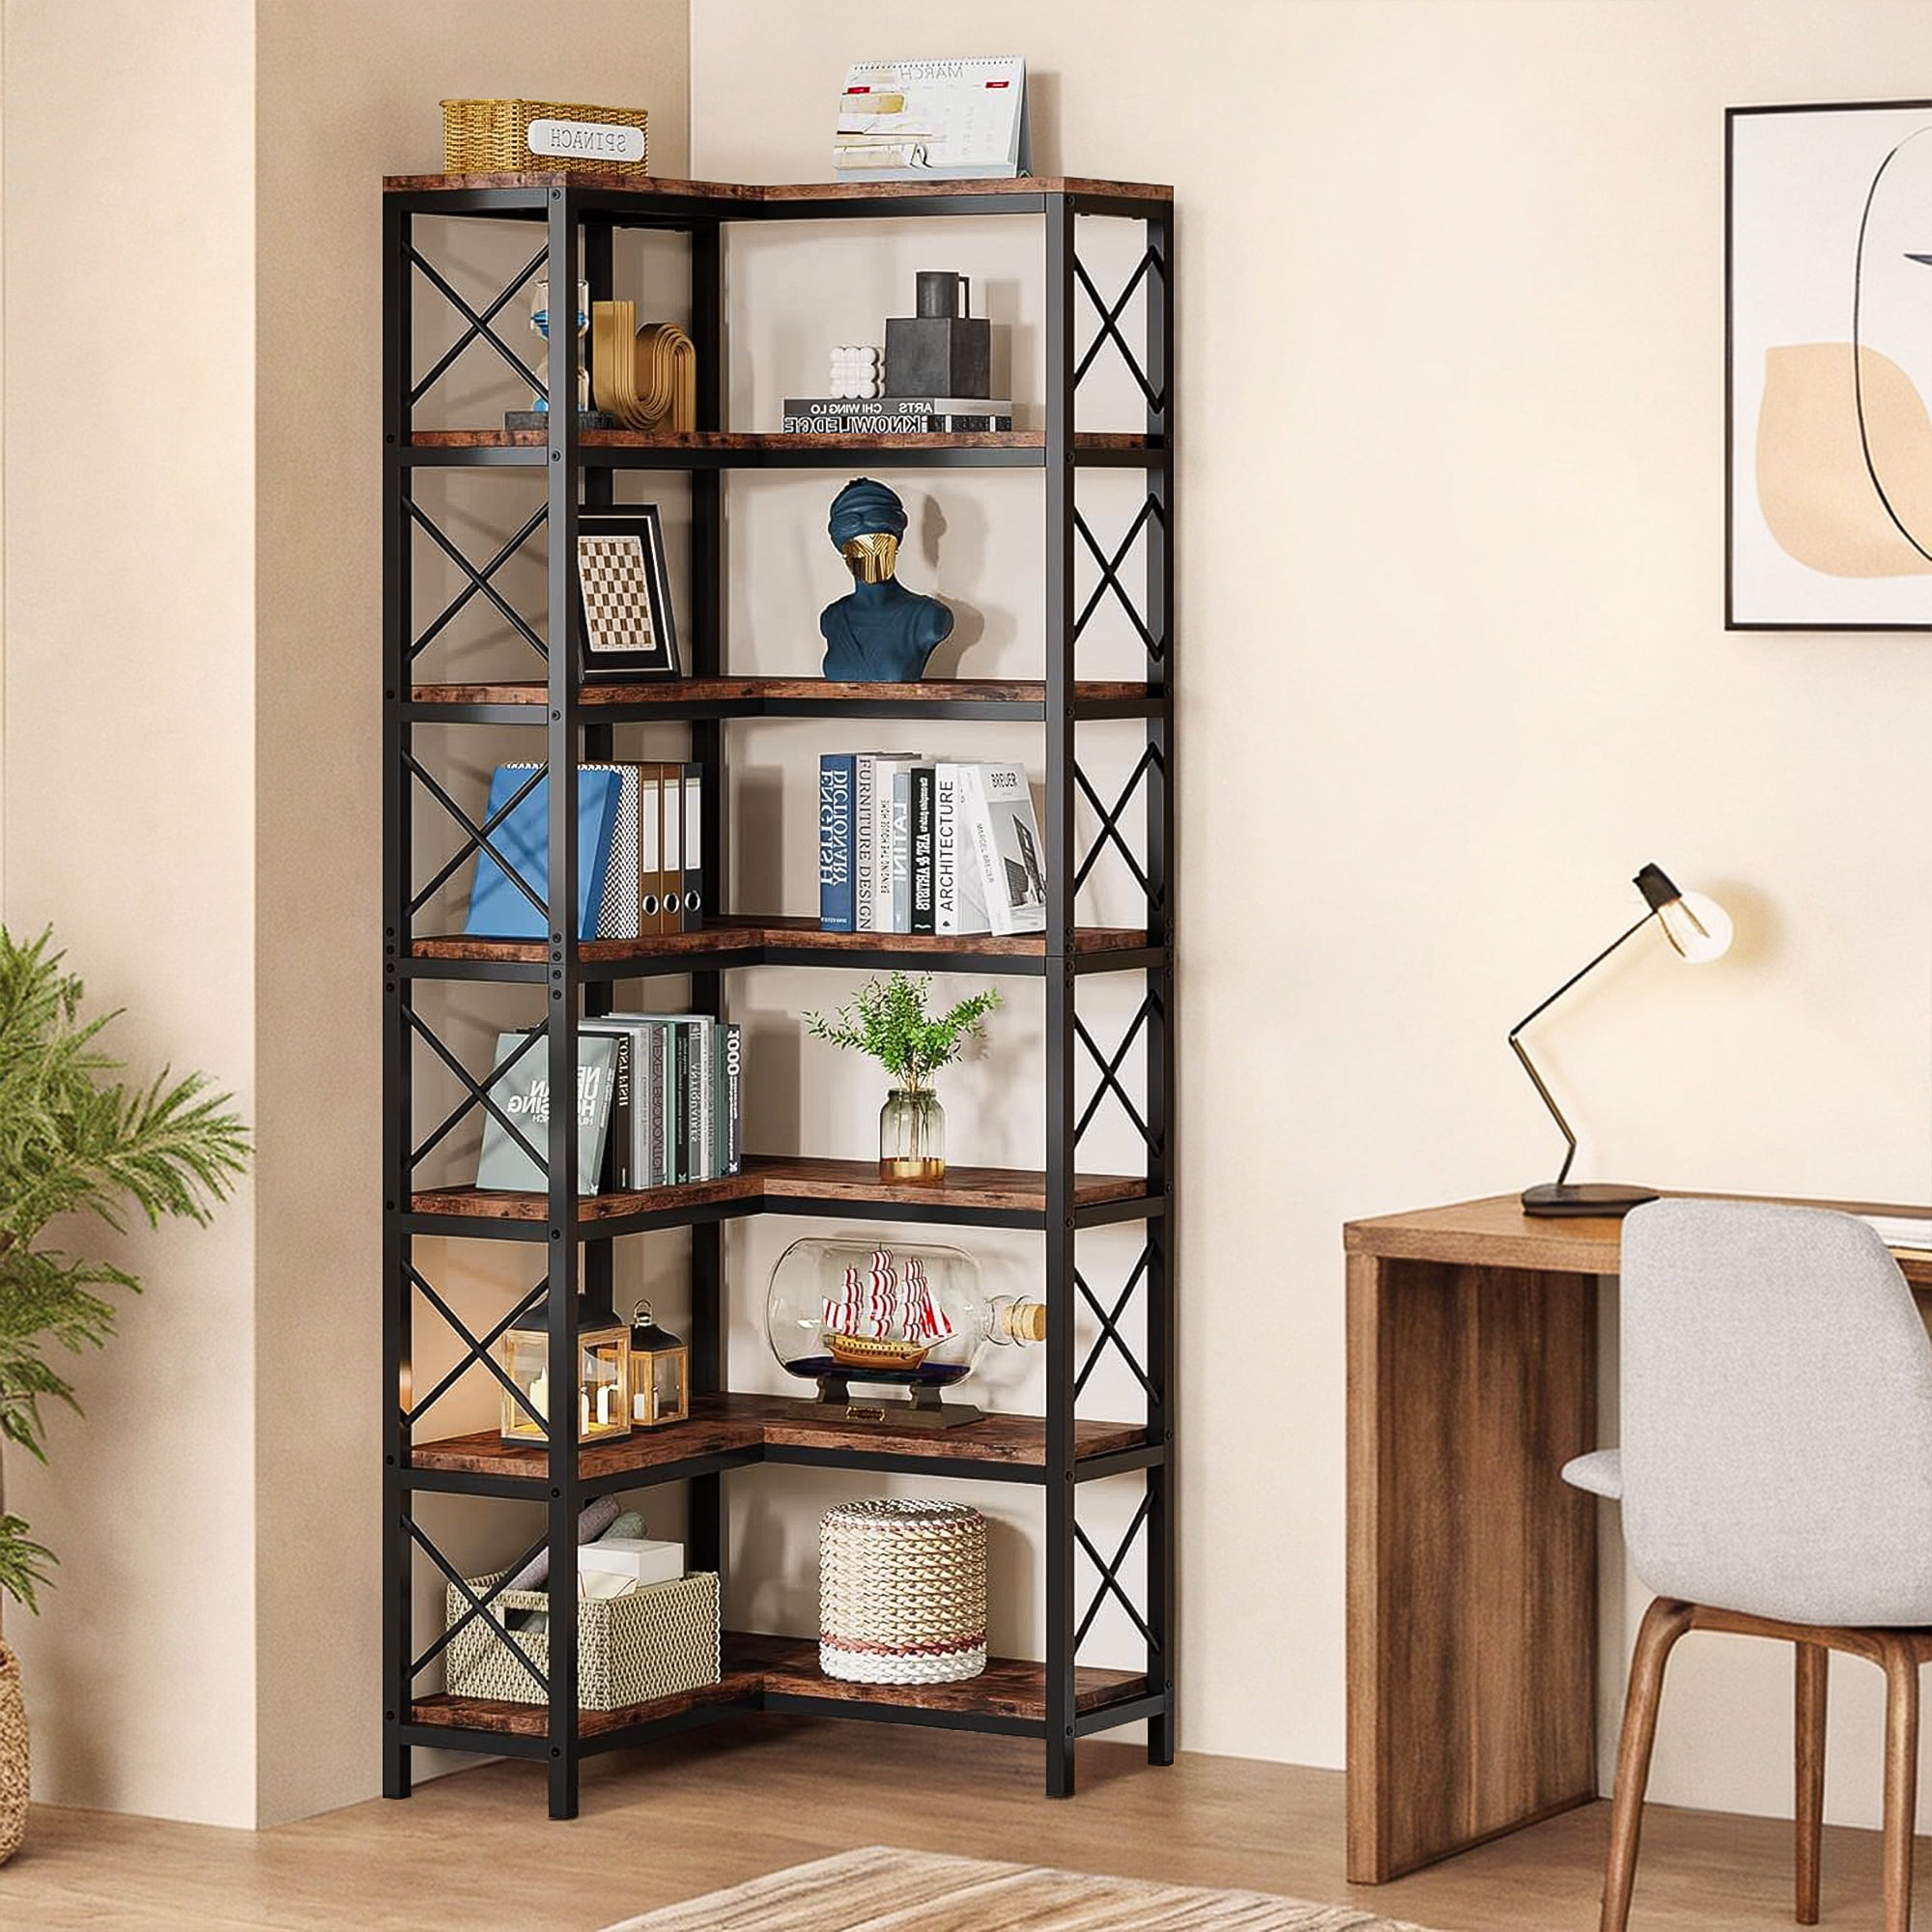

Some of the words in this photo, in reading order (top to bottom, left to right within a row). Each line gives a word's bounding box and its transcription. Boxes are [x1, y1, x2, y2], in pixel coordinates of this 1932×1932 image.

[859, 758, 871, 861] FURNITURE
[939, 781, 953, 912] ARCHITECTURE
[859, 866, 871, 929] DESIGN
